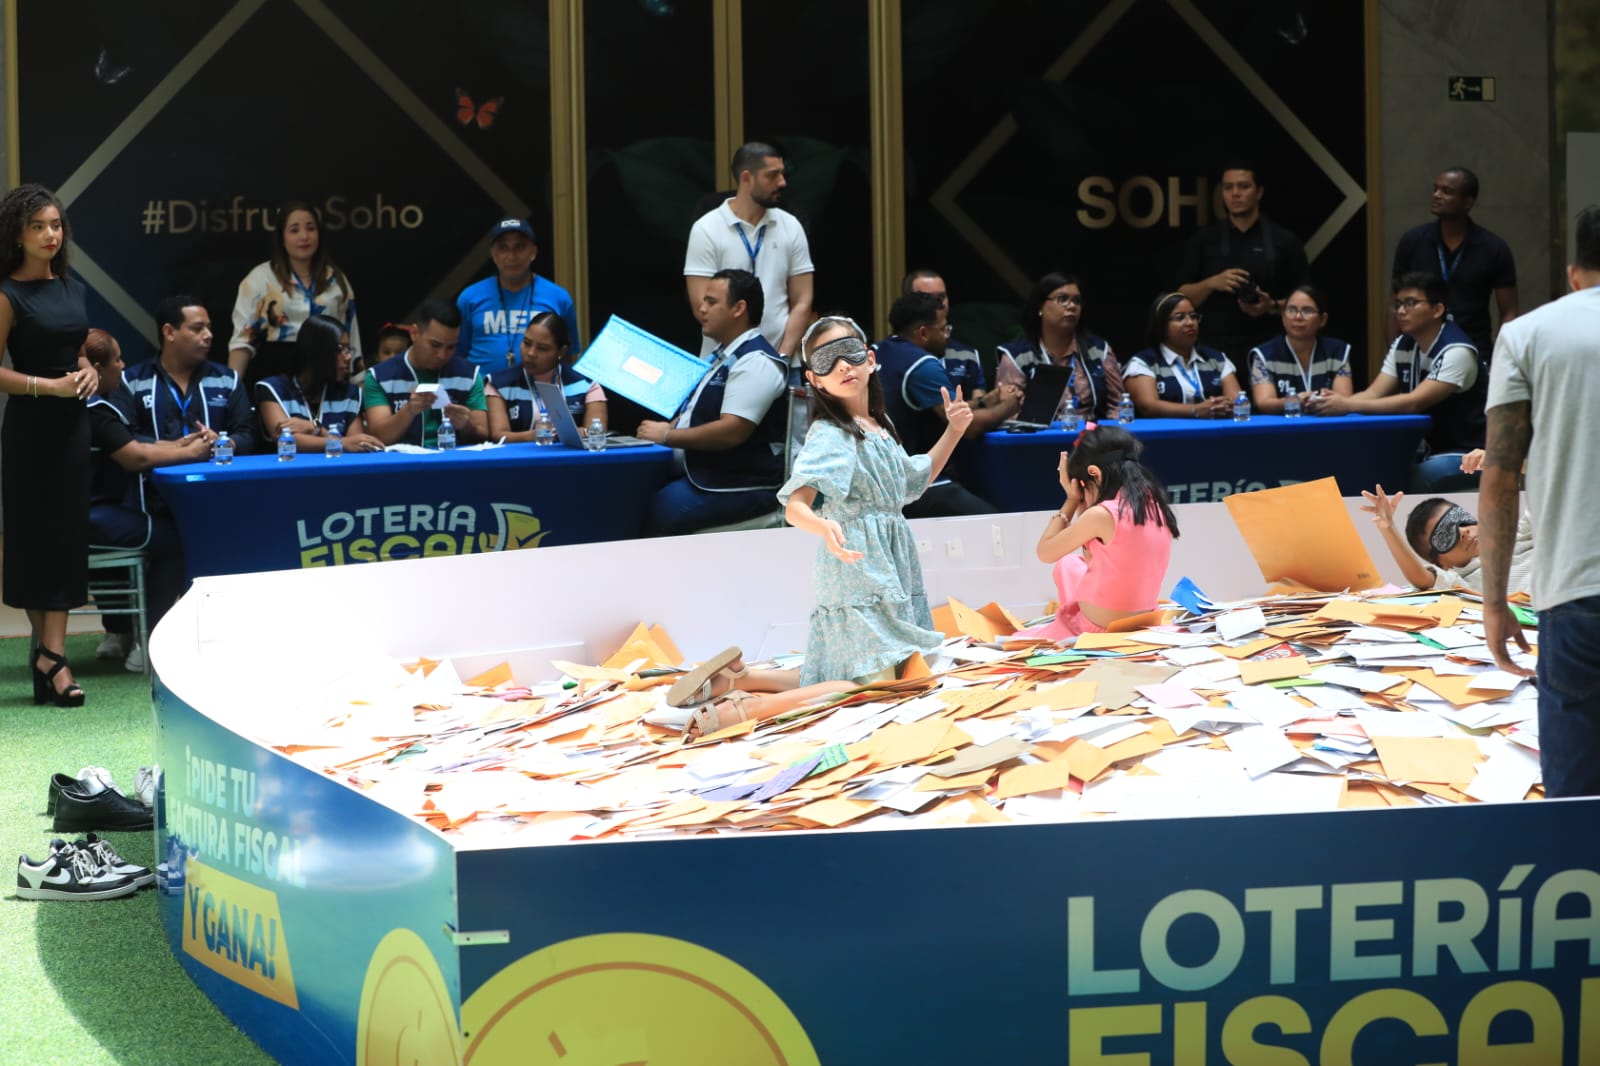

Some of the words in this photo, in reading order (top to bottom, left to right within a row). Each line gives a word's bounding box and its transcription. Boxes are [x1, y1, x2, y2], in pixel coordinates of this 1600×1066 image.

[142, 195, 424, 235] #DisfruSoho
[1076, 175, 1226, 229] SOH
[230, 767, 257, 818] TU
[167, 796, 231, 864] FACTURA
[234, 822, 307, 889] FISCAL
[188, 884, 201, 941] Y
[203, 894, 278, 981] GANA!
